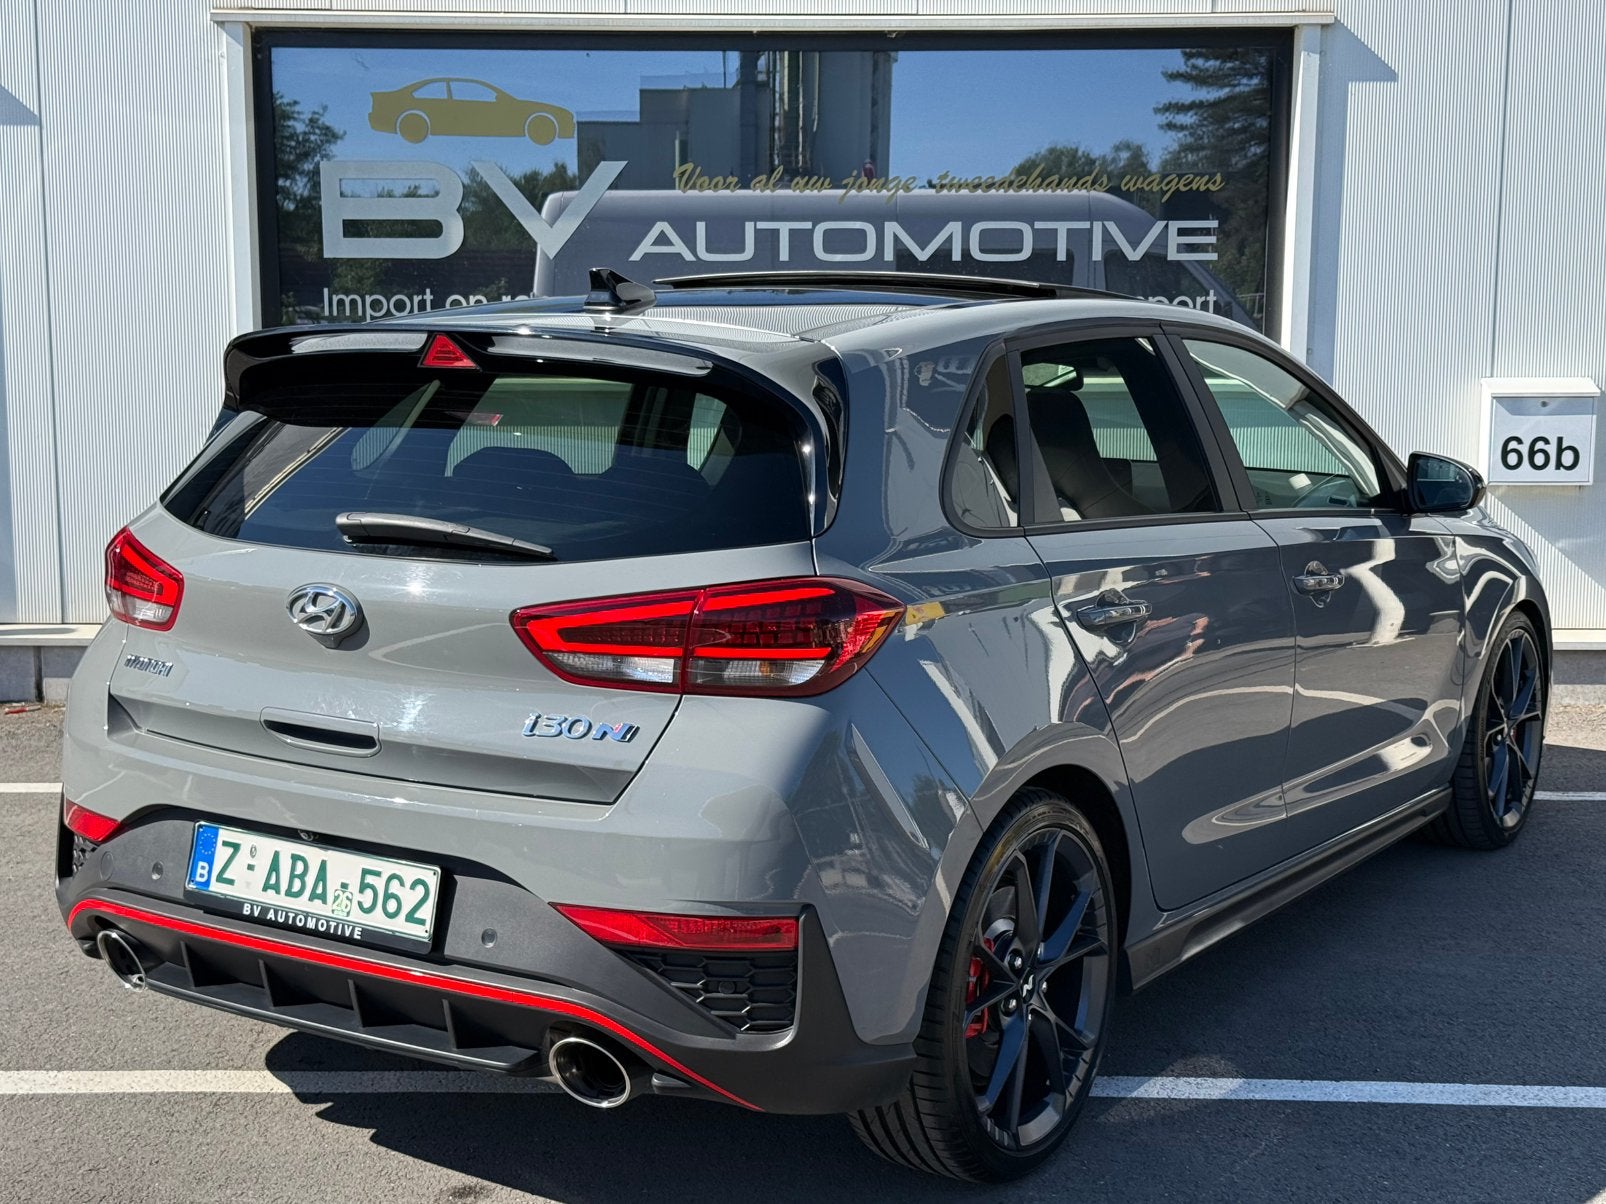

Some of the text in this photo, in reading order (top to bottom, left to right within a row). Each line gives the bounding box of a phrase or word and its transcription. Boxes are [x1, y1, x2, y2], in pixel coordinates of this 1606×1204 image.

[673, 162, 1226, 204] Voor al uw jonge tweedehands wagens
[320, 160, 1219, 262] BV AUTOMOTIVE
[323, 287, 434, 322] Import
[1500, 435, 1580, 471] 66b
[196, 861, 210, 883] B
[242, 903, 363, 940] BV AUTOMOTIVE
